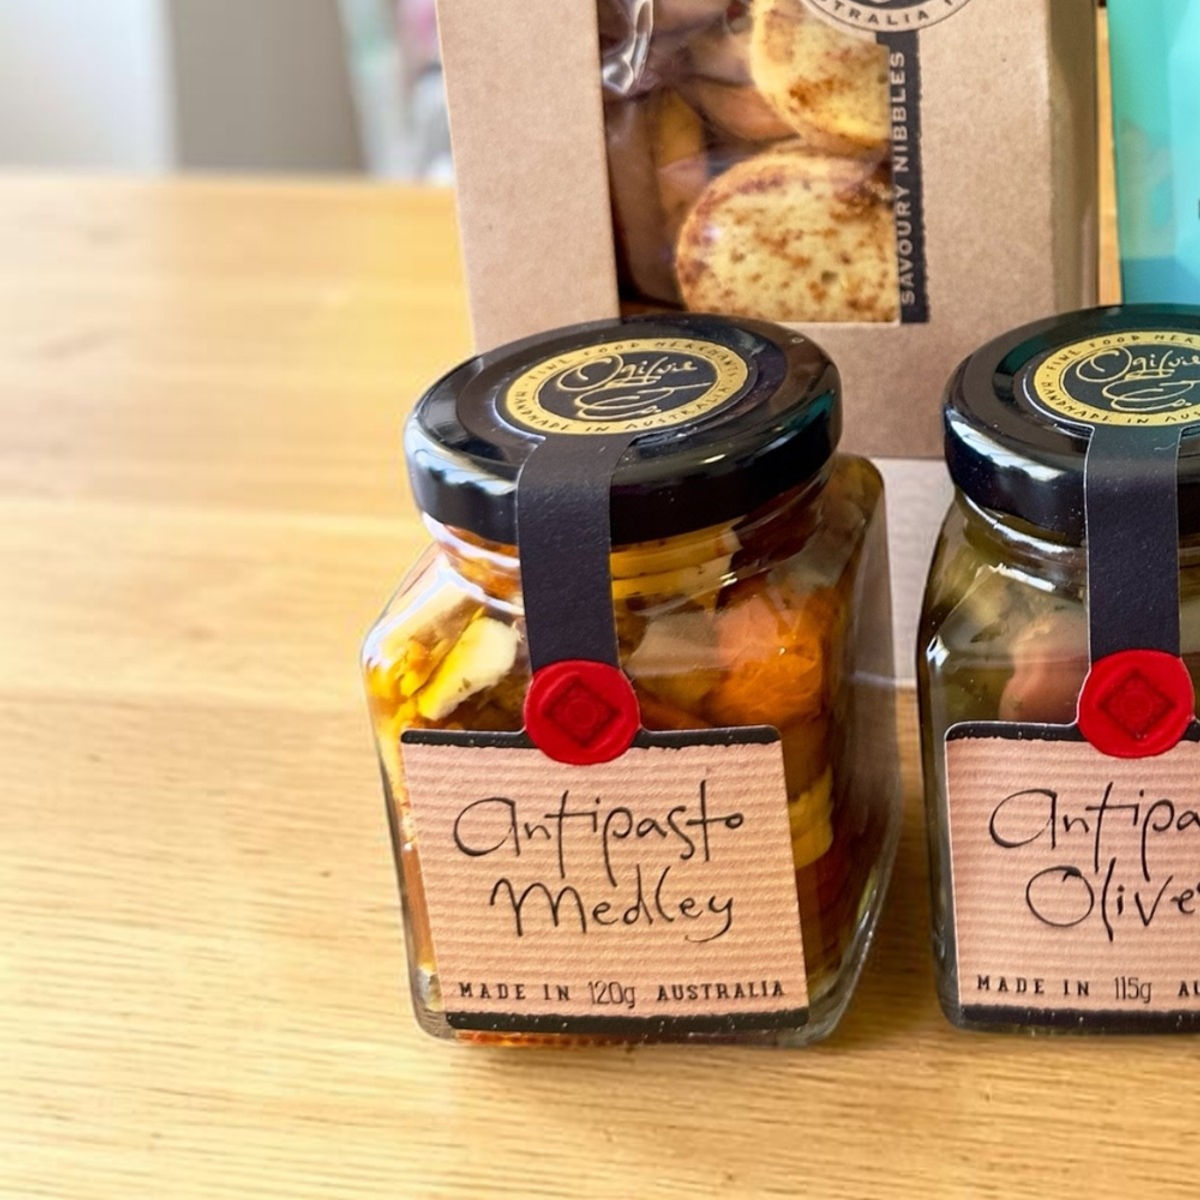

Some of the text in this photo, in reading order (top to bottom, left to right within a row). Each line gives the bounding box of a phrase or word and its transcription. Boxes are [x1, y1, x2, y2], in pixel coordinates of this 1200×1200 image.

[890, 52, 916, 306] SAVOURY NIBBLES
[585, 424, 609, 432] IN
[625, 386, 731, 431] AUSTRALIA
[1126, 416, 1150, 424] IN
[489, 864, 734, 944] Medley
[459, 980, 786, 1008] MADE IN 120g AUSTRALIA
[977, 974, 1046, 995] MADE
[1062, 978, 1090, 997] IN
[1113, 975, 1153, 1004] 115g
